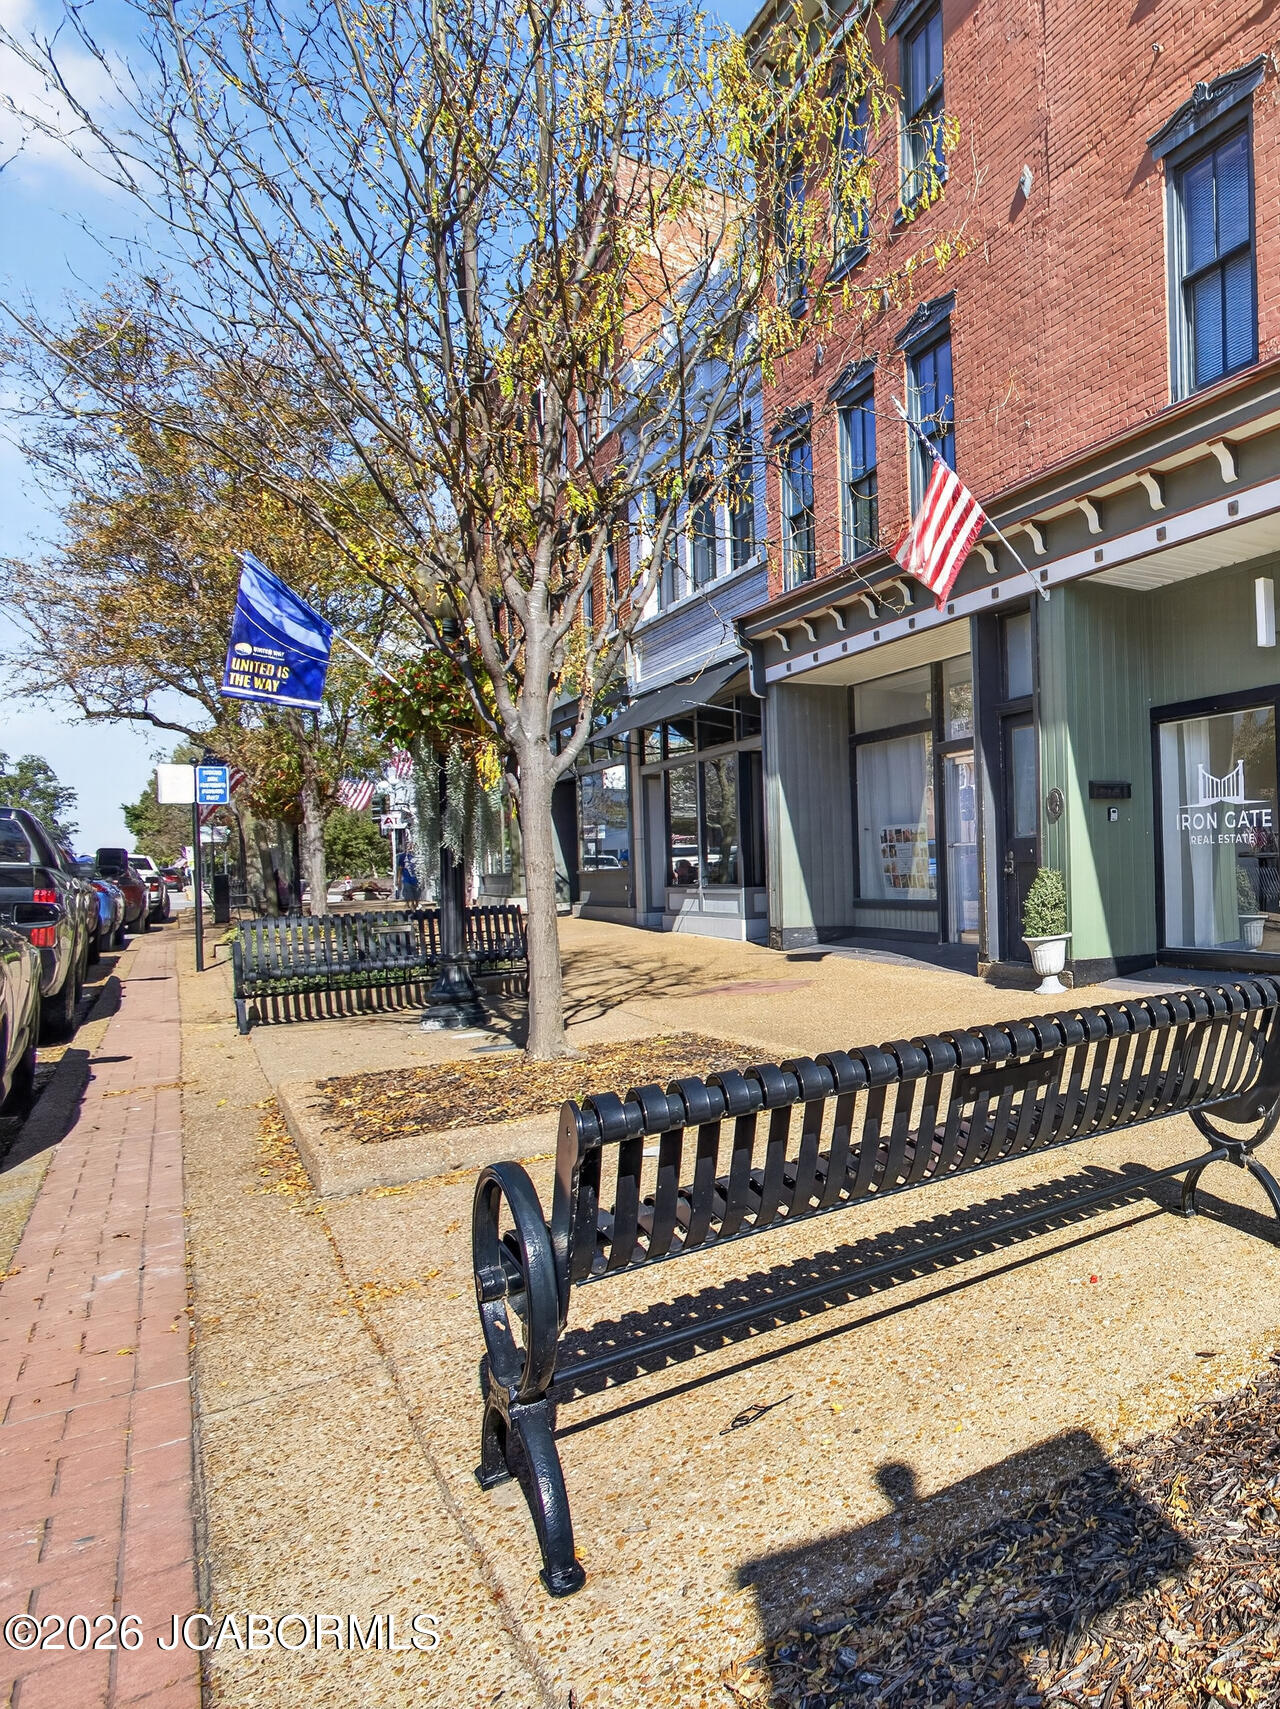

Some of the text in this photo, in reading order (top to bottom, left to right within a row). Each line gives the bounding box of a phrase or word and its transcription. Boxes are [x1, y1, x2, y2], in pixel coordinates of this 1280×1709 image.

[231, 657, 275, 677] UNITED
[276, 665, 290, 679] IS
[229, 672, 280, 693] THE WAY
[1176, 808, 1273, 831] IRON GATE
[1190, 833, 1256, 845] REAL ESTATE
